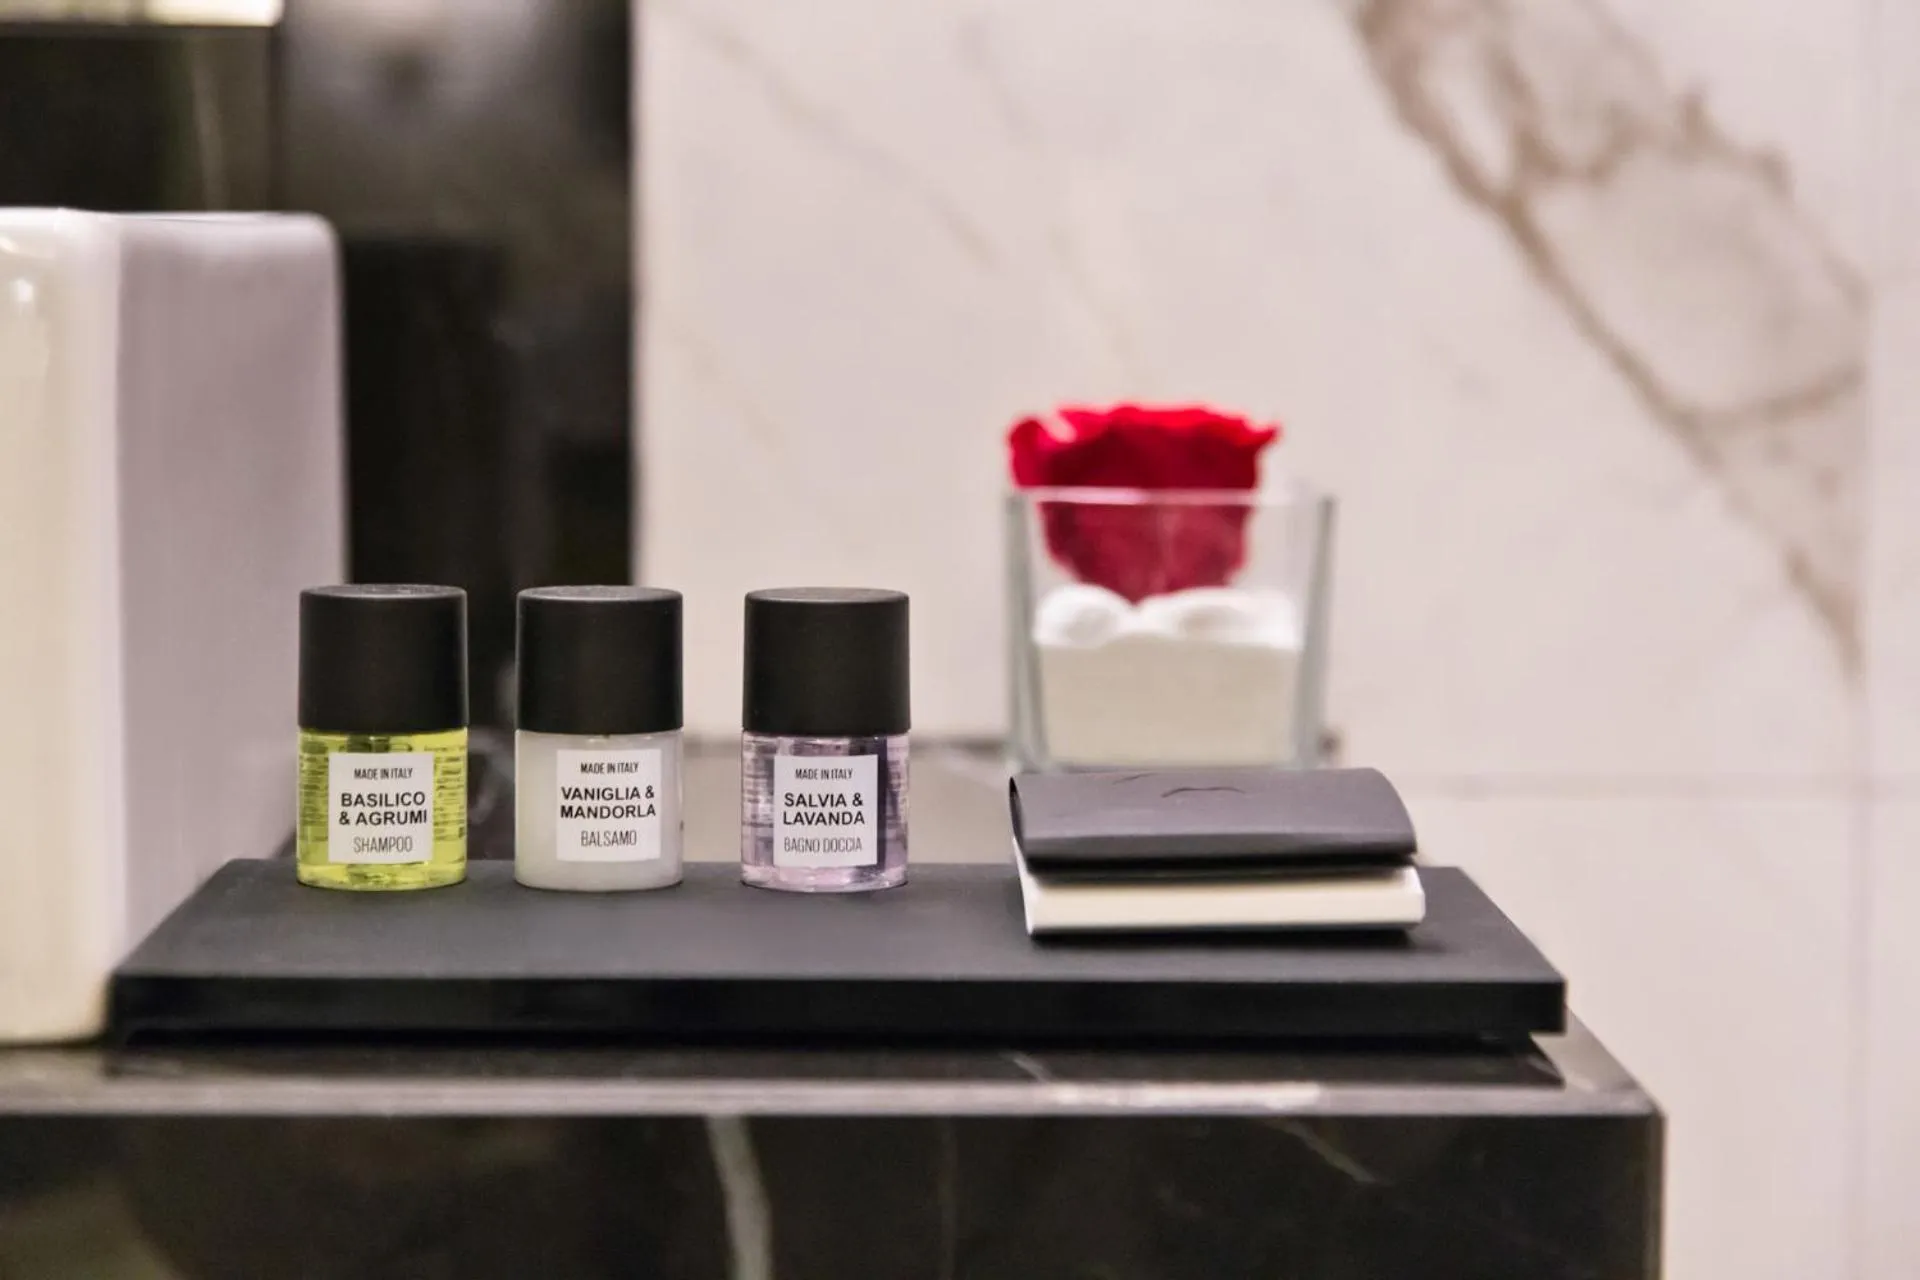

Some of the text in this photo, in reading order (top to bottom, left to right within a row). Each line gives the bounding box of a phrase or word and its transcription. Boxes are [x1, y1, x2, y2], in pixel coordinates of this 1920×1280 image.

[354, 768, 413, 779] MADE IN ITALY
[581, 762, 639, 774] MADE IN ITALY
[796, 769, 853, 780] MADE IN ITALY
[341, 791, 425, 807] BASILICO
[561, 785, 654, 801] VANIGLIA &
[784, 792, 863, 807] SALVIA &
[339, 810, 427, 825] & AGRUMI
[561, 804, 656, 819] MANDORLA
[783, 811, 865, 825] LAVANDA
[354, 836, 413, 853] SHAMPOO
[581, 830, 637, 847] BALSAMO
[784, 837, 862, 853] BAGNO DOCCIA
